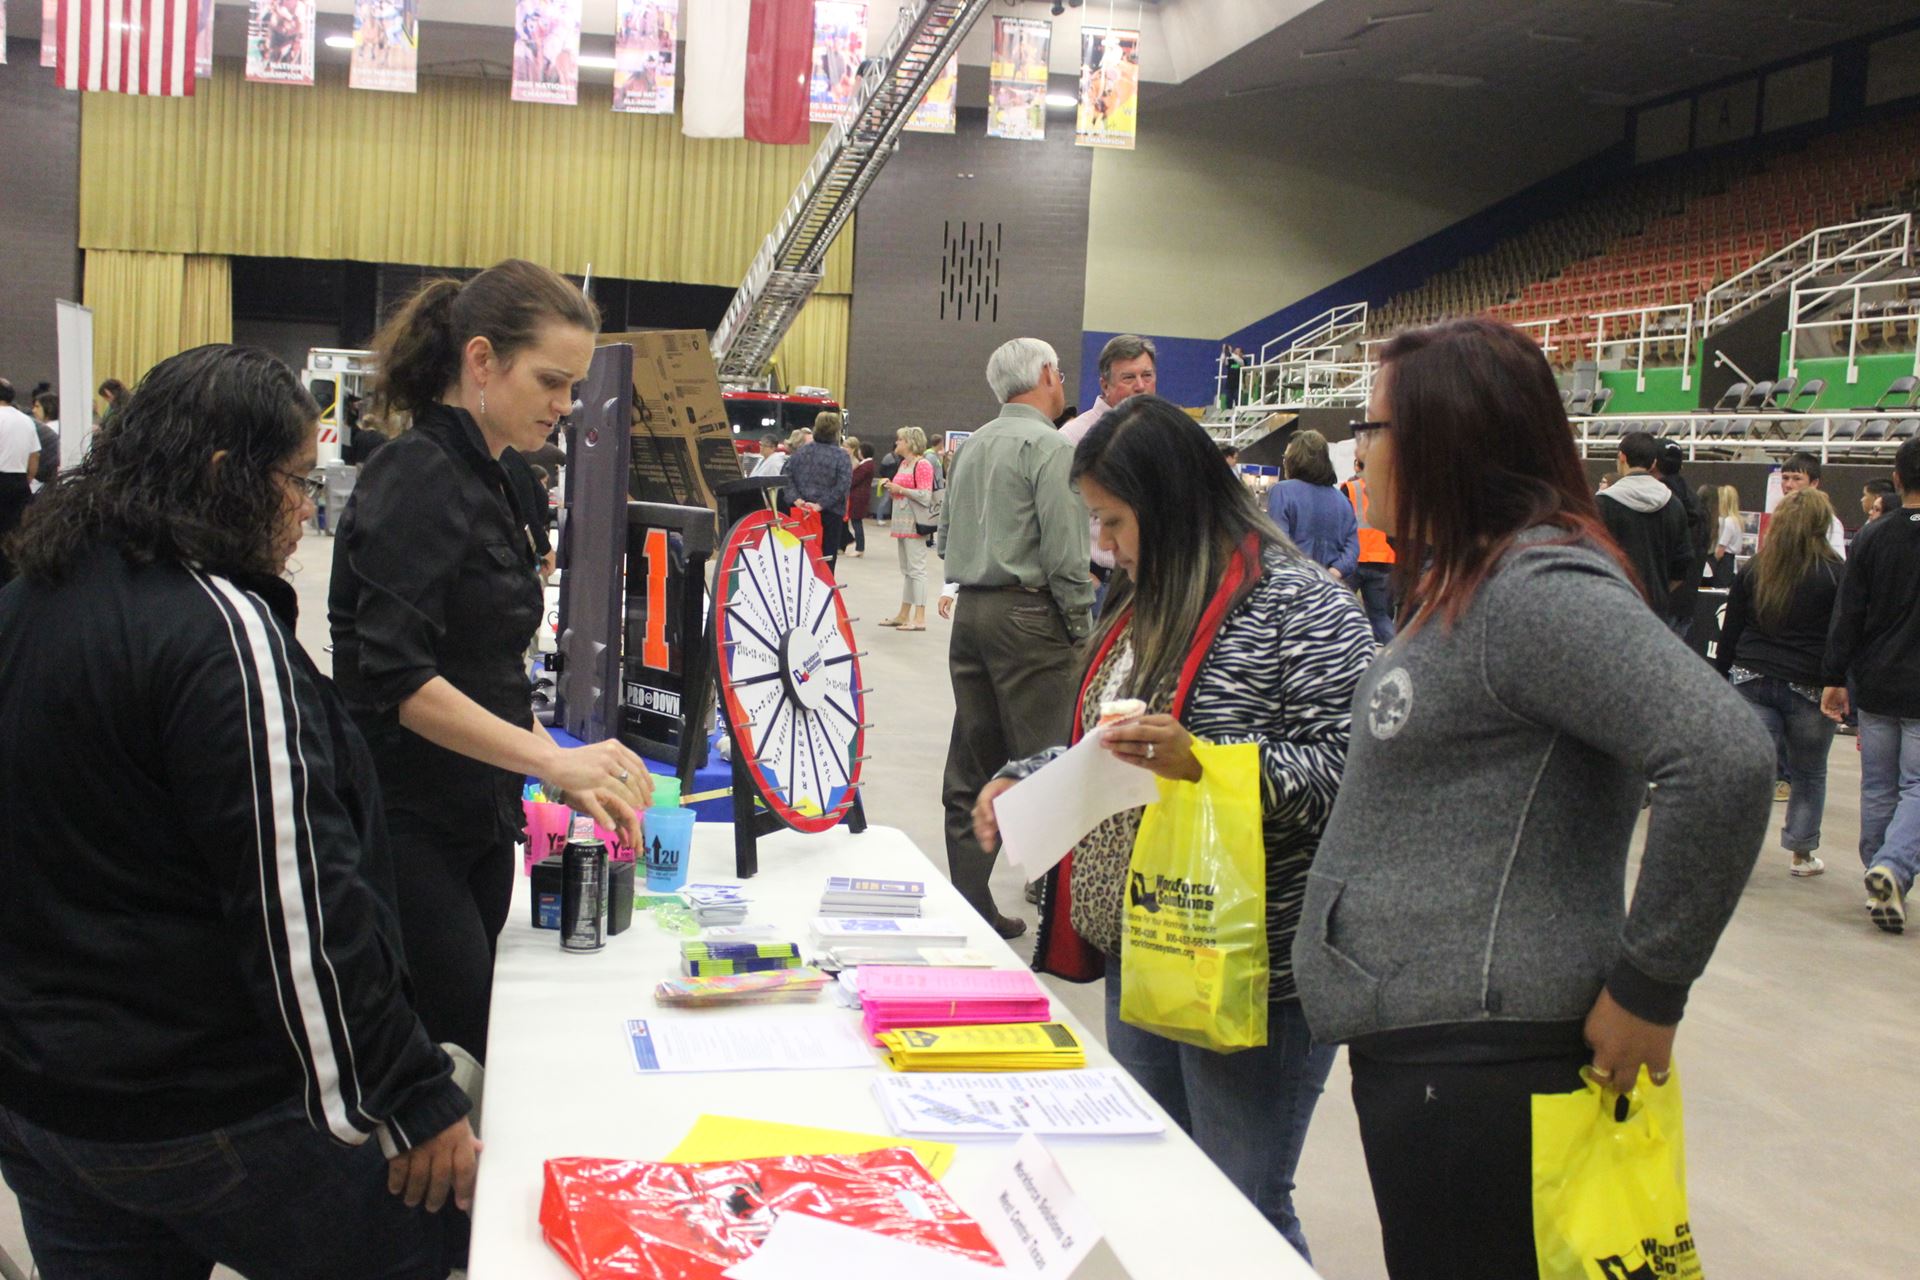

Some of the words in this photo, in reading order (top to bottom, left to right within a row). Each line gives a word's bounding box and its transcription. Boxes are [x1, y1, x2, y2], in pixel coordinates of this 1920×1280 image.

[627, 685, 645, 706] PRO
[652, 691, 680, 716] DOWN
[1014, 1160, 1041, 1203] Workforce
